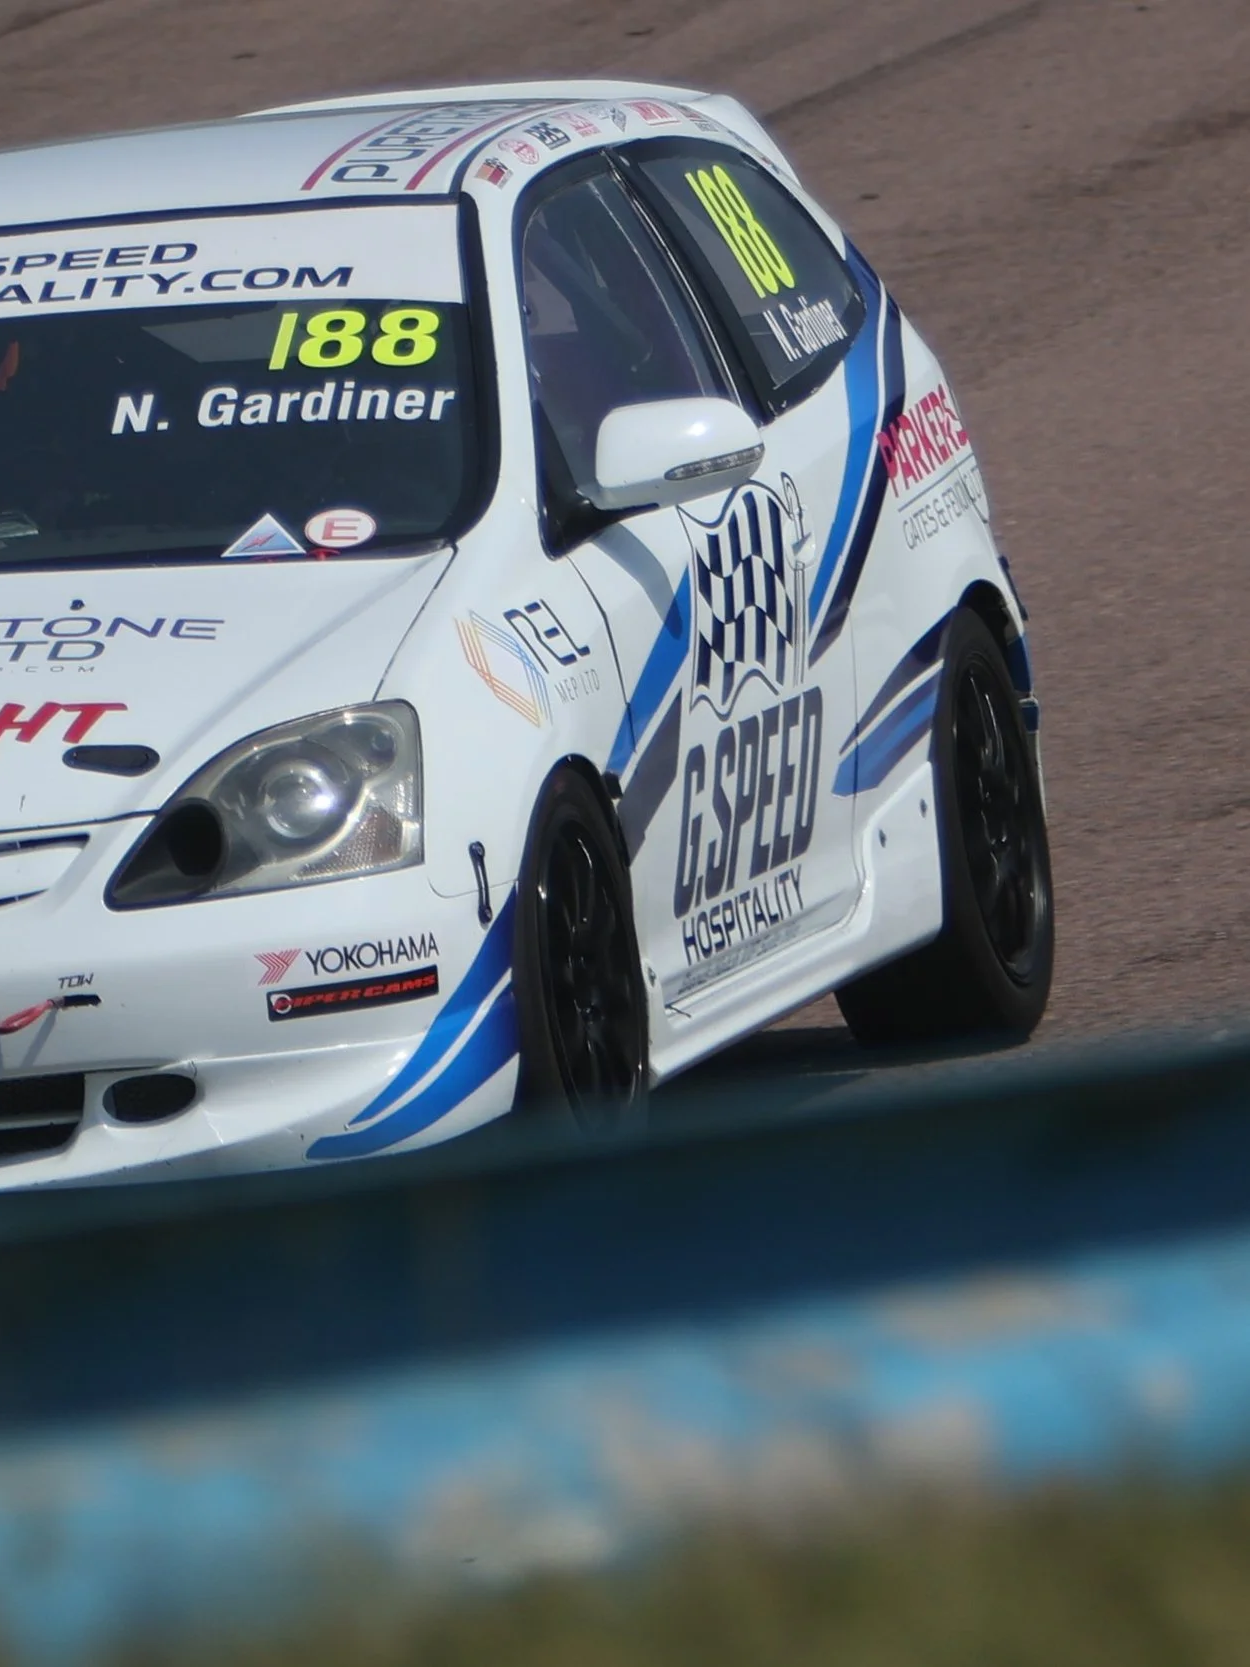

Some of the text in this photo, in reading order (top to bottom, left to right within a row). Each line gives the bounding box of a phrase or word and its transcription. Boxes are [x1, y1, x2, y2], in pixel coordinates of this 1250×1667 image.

[685, 165, 795, 299] 188
[268, 309, 441, 371] 188
[111, 381, 455, 435] N. Gardiner
[876, 383, 969, 498] PARKERS
[321, 517, 361, 541] E
[681, 863, 804, 967] HOSPITALITY
[58, 972, 94, 989] TOW
[305, 931, 440, 976] YOKOHAMA
